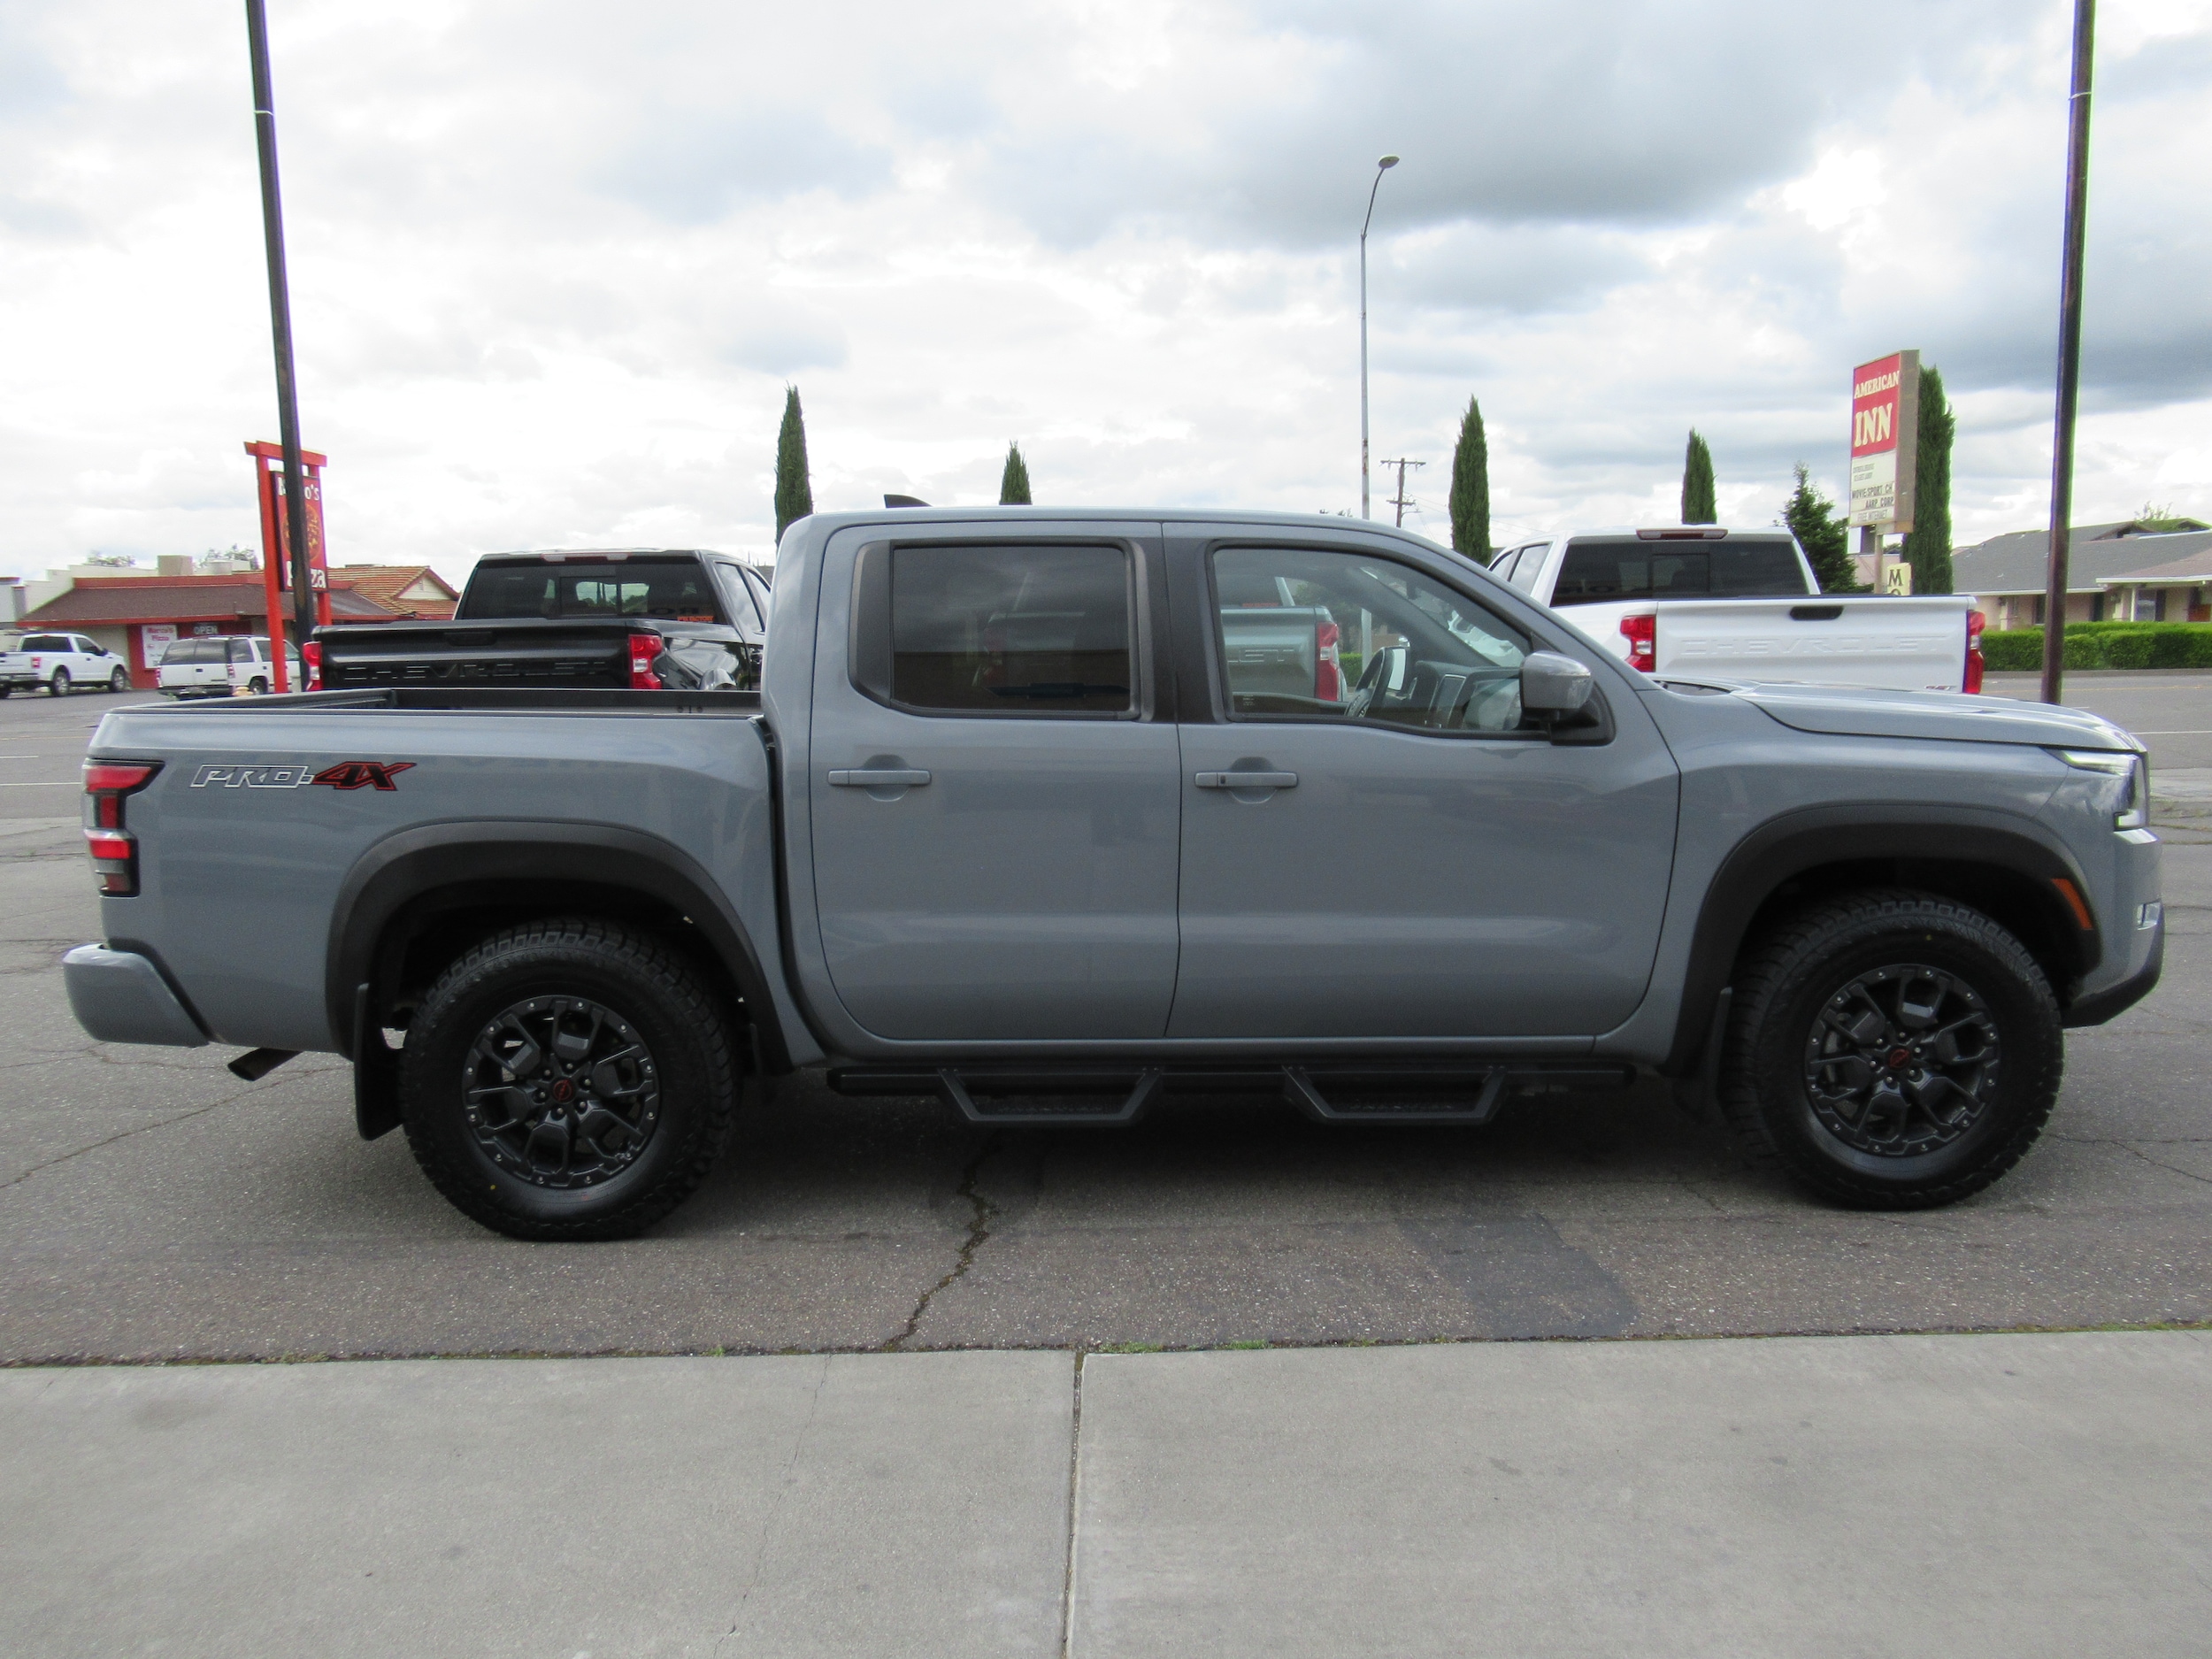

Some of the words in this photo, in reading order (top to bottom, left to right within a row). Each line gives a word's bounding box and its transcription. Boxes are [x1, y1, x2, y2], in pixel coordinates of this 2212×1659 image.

[1855, 371, 1900, 399] AMERICAN
[1855, 403, 1893, 447] INN
[194, 626, 219, 635] OPEN
[1680, 634, 1947, 656] CHEVROLET
[344, 661, 607, 681] CHEVROLET
